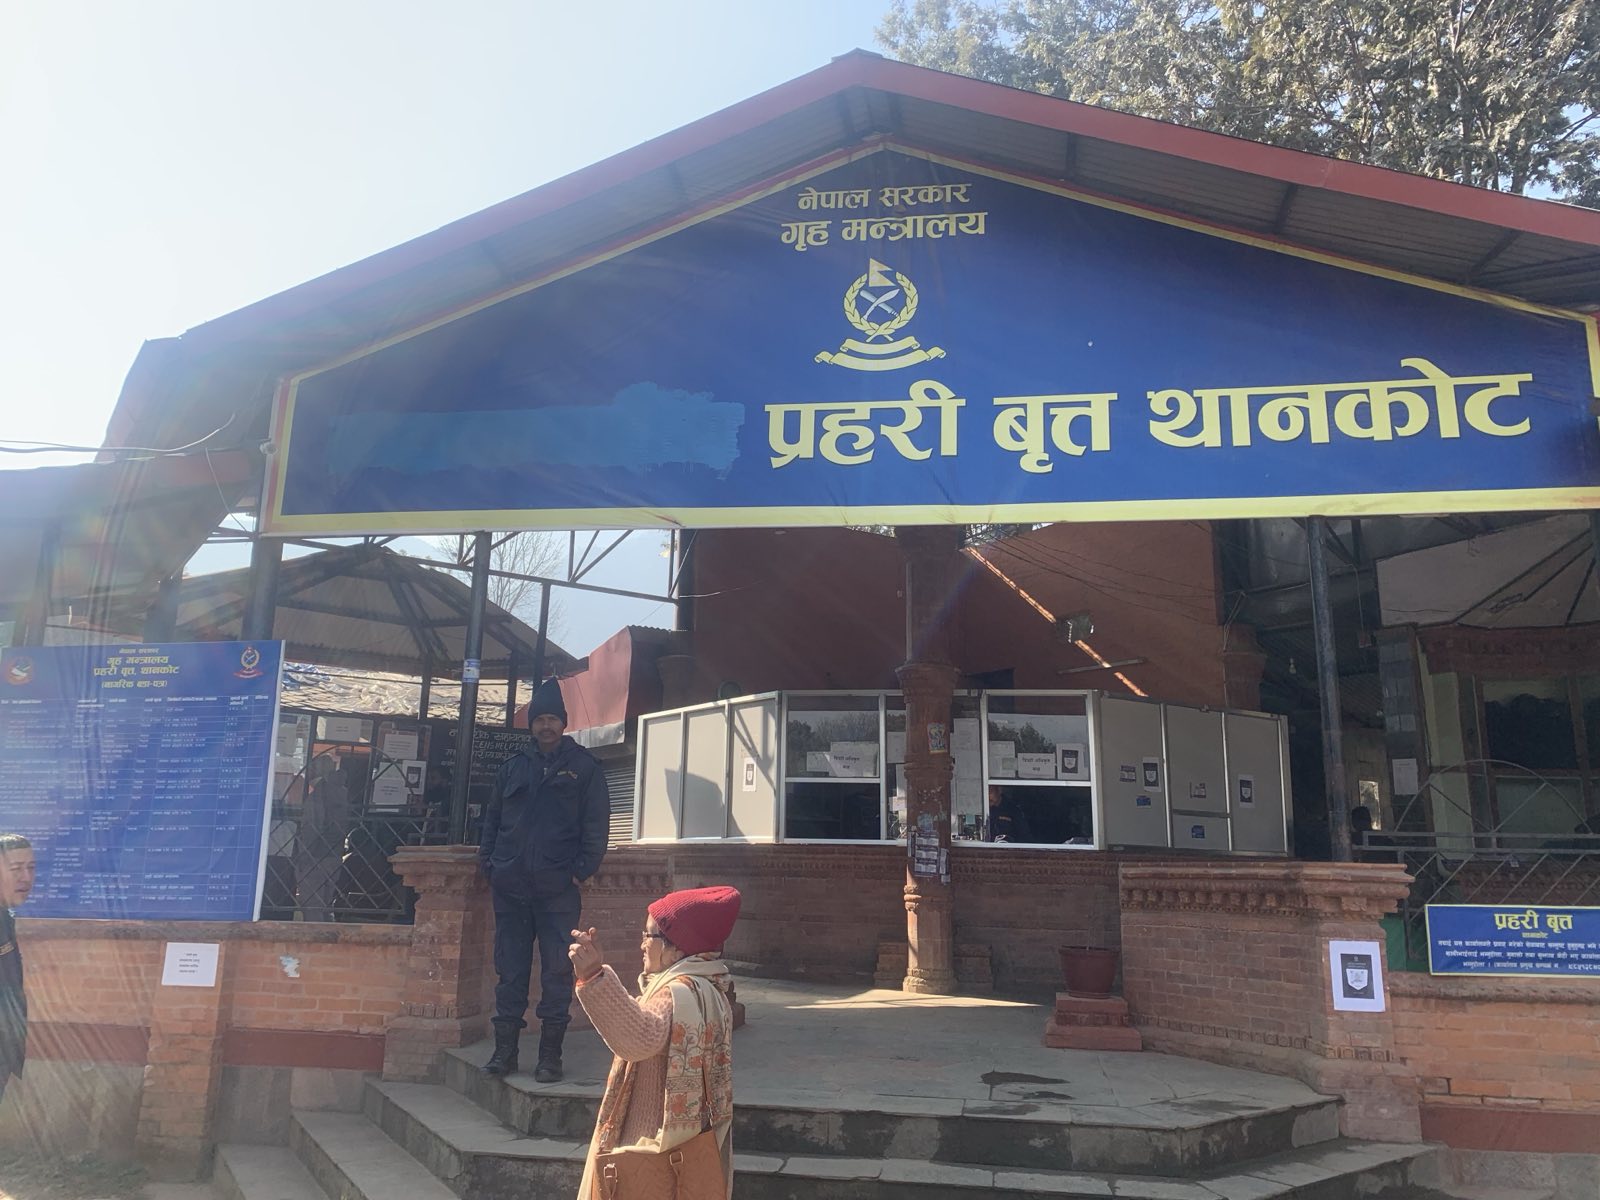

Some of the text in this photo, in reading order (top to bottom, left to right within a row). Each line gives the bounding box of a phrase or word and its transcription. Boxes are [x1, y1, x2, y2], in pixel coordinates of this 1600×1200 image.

[798, 183, 972, 210] नेपाल सरकार
[781, 212, 988, 251] गृह मन्त्रालय
[764, 358, 1534, 473] प्रहरी बृत्त थानकोट
[94, 665, 117, 676] प्रहरी
[107, 656, 169, 667] गृह मन्त्रालय
[1494, 909, 1539, 930] प्रहरी
